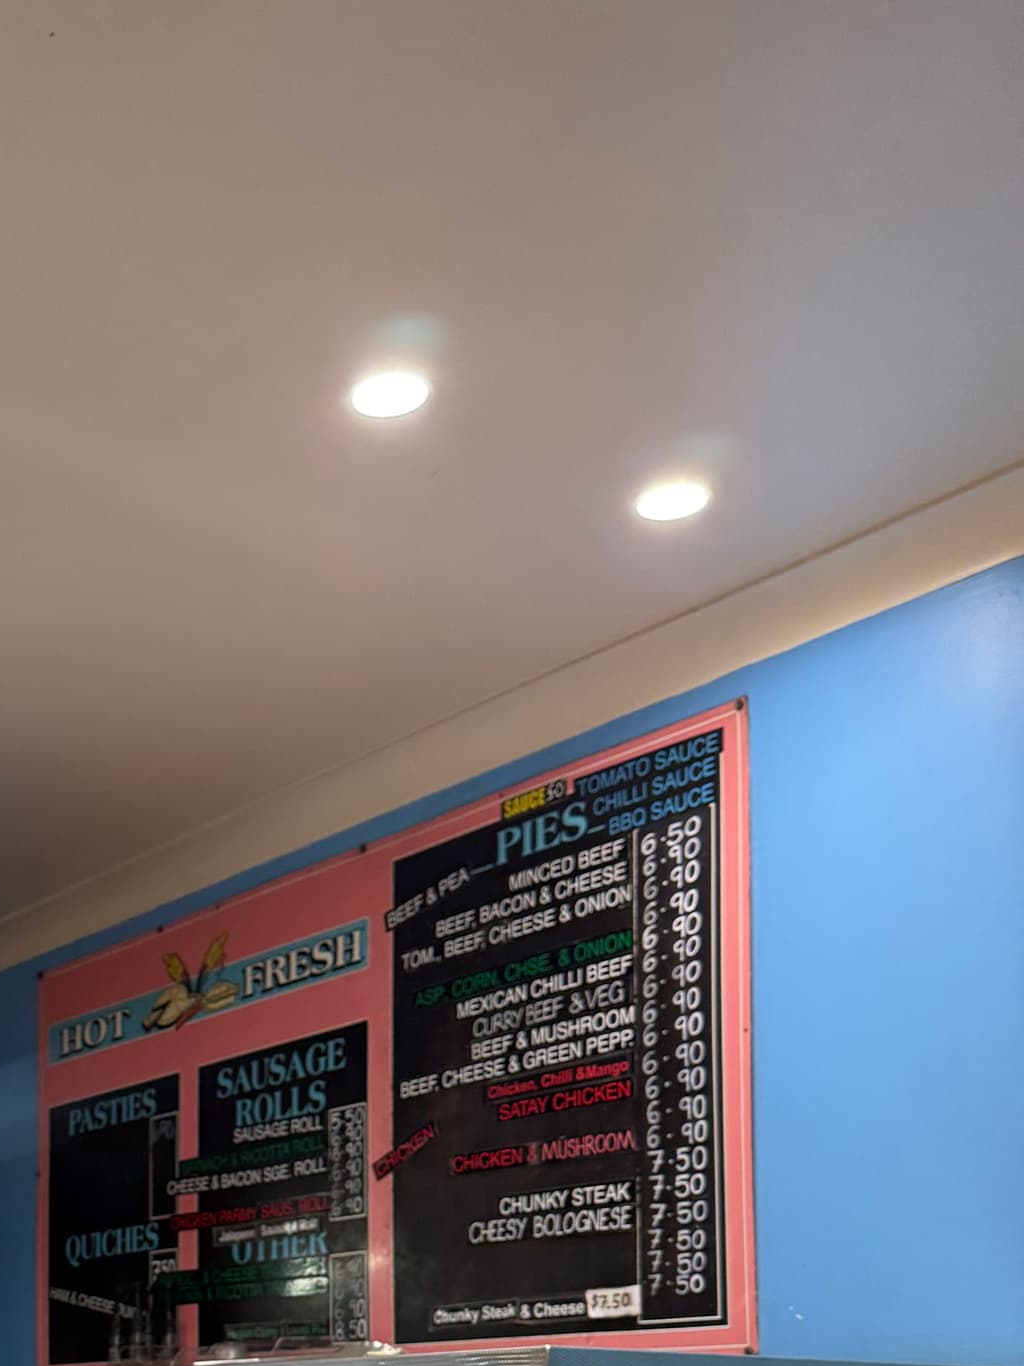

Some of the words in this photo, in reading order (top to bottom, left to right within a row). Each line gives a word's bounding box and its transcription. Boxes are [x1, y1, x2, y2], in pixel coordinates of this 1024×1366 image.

[577, 758, 650, 797] TOMATO
[654, 733, 719, 770] SAUCE
[592, 782, 648, 816] CHILLI
[652, 757, 716, 796] SAUCE
[503, 787, 546, 818] SAUCE
[608, 808, 646, 836] BBQ
[650, 782, 715, 821] SAUCE
[496, 802, 588, 866] PIES
[508, 855, 575, 891] MINCED
[578, 837, 626, 870] BEEF
[386, 893, 425, 929] BEEF
[426, 887, 437, 903] &
[438, 868, 470, 896] PEA
[479, 892, 536, 924] BACON
[538, 885, 551, 903] &
[554, 862, 628, 899] CHEESE
[488, 908, 557, 944] CHEESE
[558, 904, 571, 922] &
[574, 884, 632, 918] ONION
[242, 930, 362, 999] FRESH
[558, 949, 571, 967] &
[575, 929, 633, 961] ONION
[456, 984, 527, 1020] MEXICAN
[530, 968, 584, 998] CHILLI
[585, 955, 632, 983] BEEF
[59, 1009, 130, 1057] HOT
[471, 1035, 514, 1060] BEEF
[516, 1031, 529, 1049] &
[531, 1005, 635, 1045] MUSHROOM
[473, 1007, 523, 1037] CURRY
[525, 995, 564, 1024] BEEF
[216, 1037, 347, 1099] SAUSAGE
[441, 1059, 506, 1089] CHEESE
[508, 1055, 519, 1073] &
[523, 1040, 584, 1069] GREEN
[586, 1029, 634, 1055] PEPP.
[540, 1073, 573, 1089] Chilli
[68, 1088, 156, 1136] PASTIES
[235, 1080, 328, 1128] ROLLS
[498, 1097, 549, 1121] SATAY
[552, 1082, 631, 1110] CHICKEN
[233, 1120, 289, 1145] SAUSAGE
[290, 1115, 323, 1134] ROLL
[376, 1126, 435, 1176] CHICKEN
[450, 1149, 522, 1172] CHICKEN
[542, 1130, 636, 1160] MUSHROOM
[167, 1177, 209, 1195] CHEESE
[211, 1174, 219, 1190] &
[221, 1168, 261, 1189] BACON
[294, 1156, 328, 1176] ROLL
[499, 1190, 570, 1215] CHUNKY
[571, 1182, 631, 1206] STEAK
[173, 1210, 216, 1230] CHICKEN
[469, 1218, 528, 1244] CHEESY
[533, 1206, 633, 1238] BOLOGNESE
[65, 1221, 160, 1268] QUICHES
[231, 1232, 328, 1265] OTHER
[433, 1308, 479, 1325] Chunky
[482, 1303, 515, 1319] Steak
[520, 1305, 530, 1318] &
[533, 1301, 585, 1317] Cheese
[591, 1292, 632, 1309] $7.50
